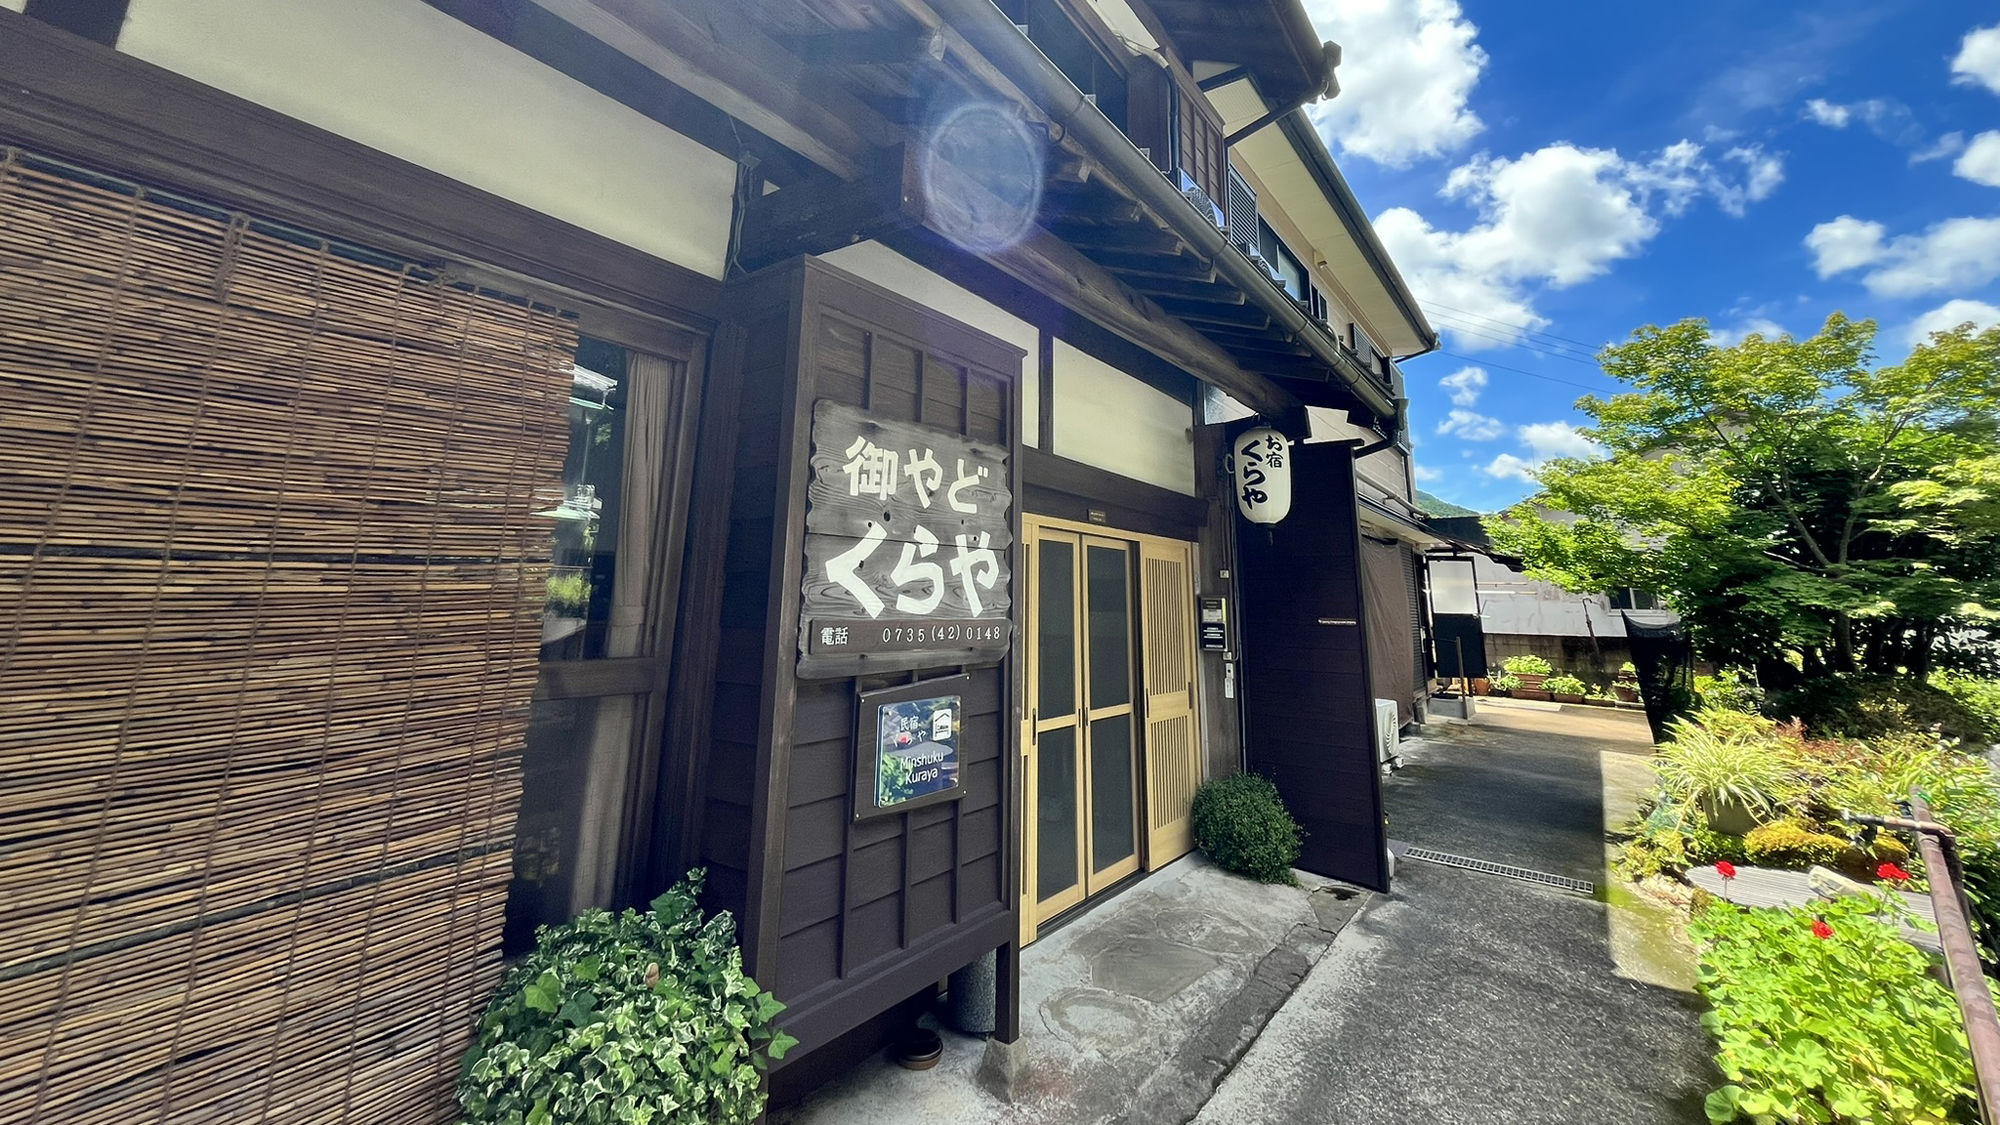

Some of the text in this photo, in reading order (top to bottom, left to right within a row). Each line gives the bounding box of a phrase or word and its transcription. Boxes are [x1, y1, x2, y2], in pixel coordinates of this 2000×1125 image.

[1266, 435, 1284, 468] お宿
[842, 436, 988, 513] 御やど
[1241, 440, 1268, 510] くらや
[825, 521, 999, 618] くらや
[820, 627, 848, 645] 電話
[900, 716, 919, 730] 民宿
[901, 752, 944, 769] Minshuku
[905, 768, 938, 785] Kuraya
